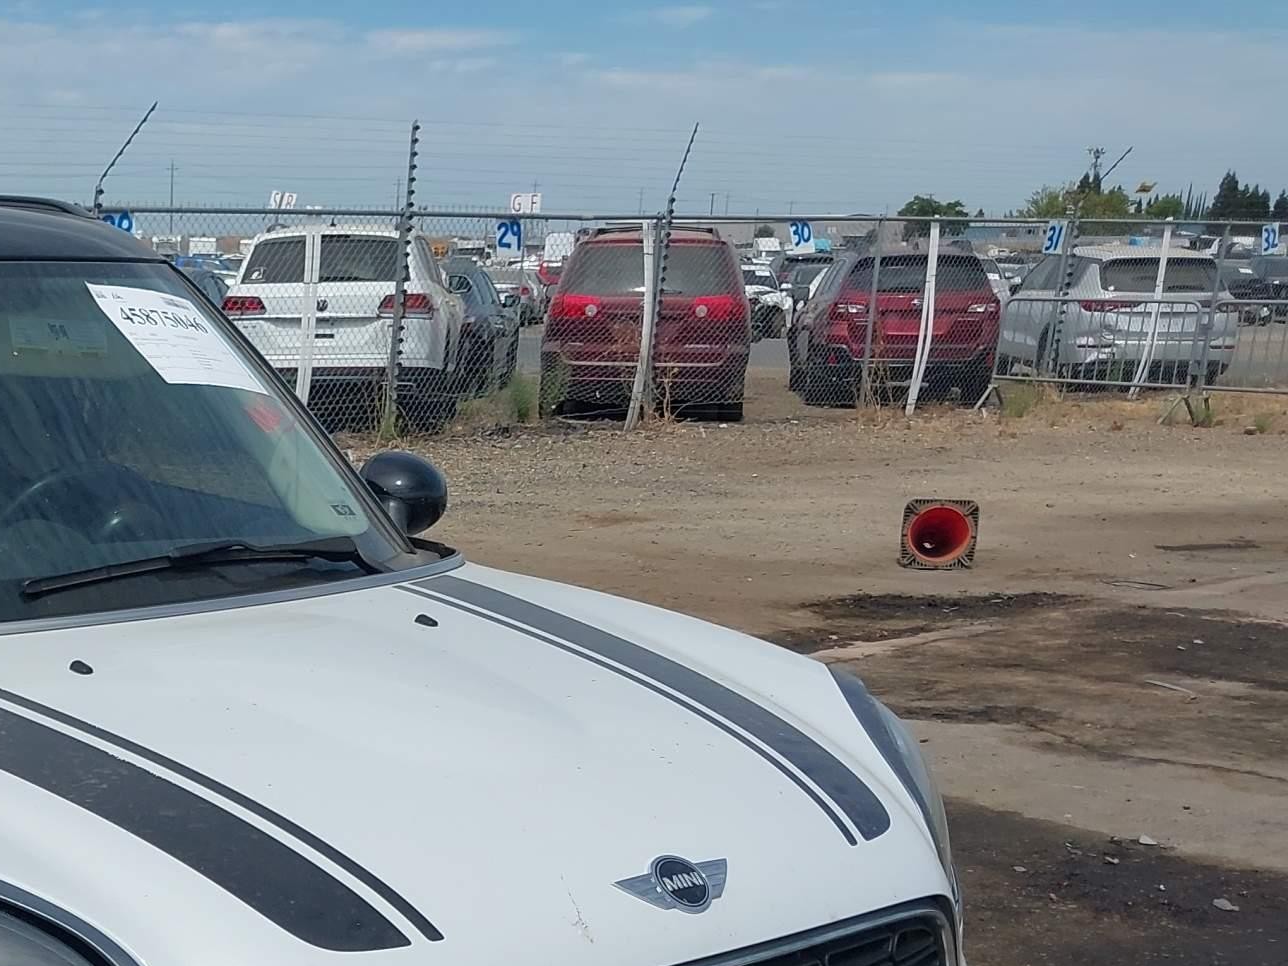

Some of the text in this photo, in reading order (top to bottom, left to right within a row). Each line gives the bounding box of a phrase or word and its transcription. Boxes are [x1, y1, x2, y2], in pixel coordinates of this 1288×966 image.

[512, 194, 521, 212] G
[497, 219, 521, 251] 29
[790, 221, 811, 247] 30
[1044, 225, 1063, 251] 31
[1263, 227, 1279, 252] 32
[119, 306, 209, 334] 45875046
[662, 871, 705, 891] MINI
